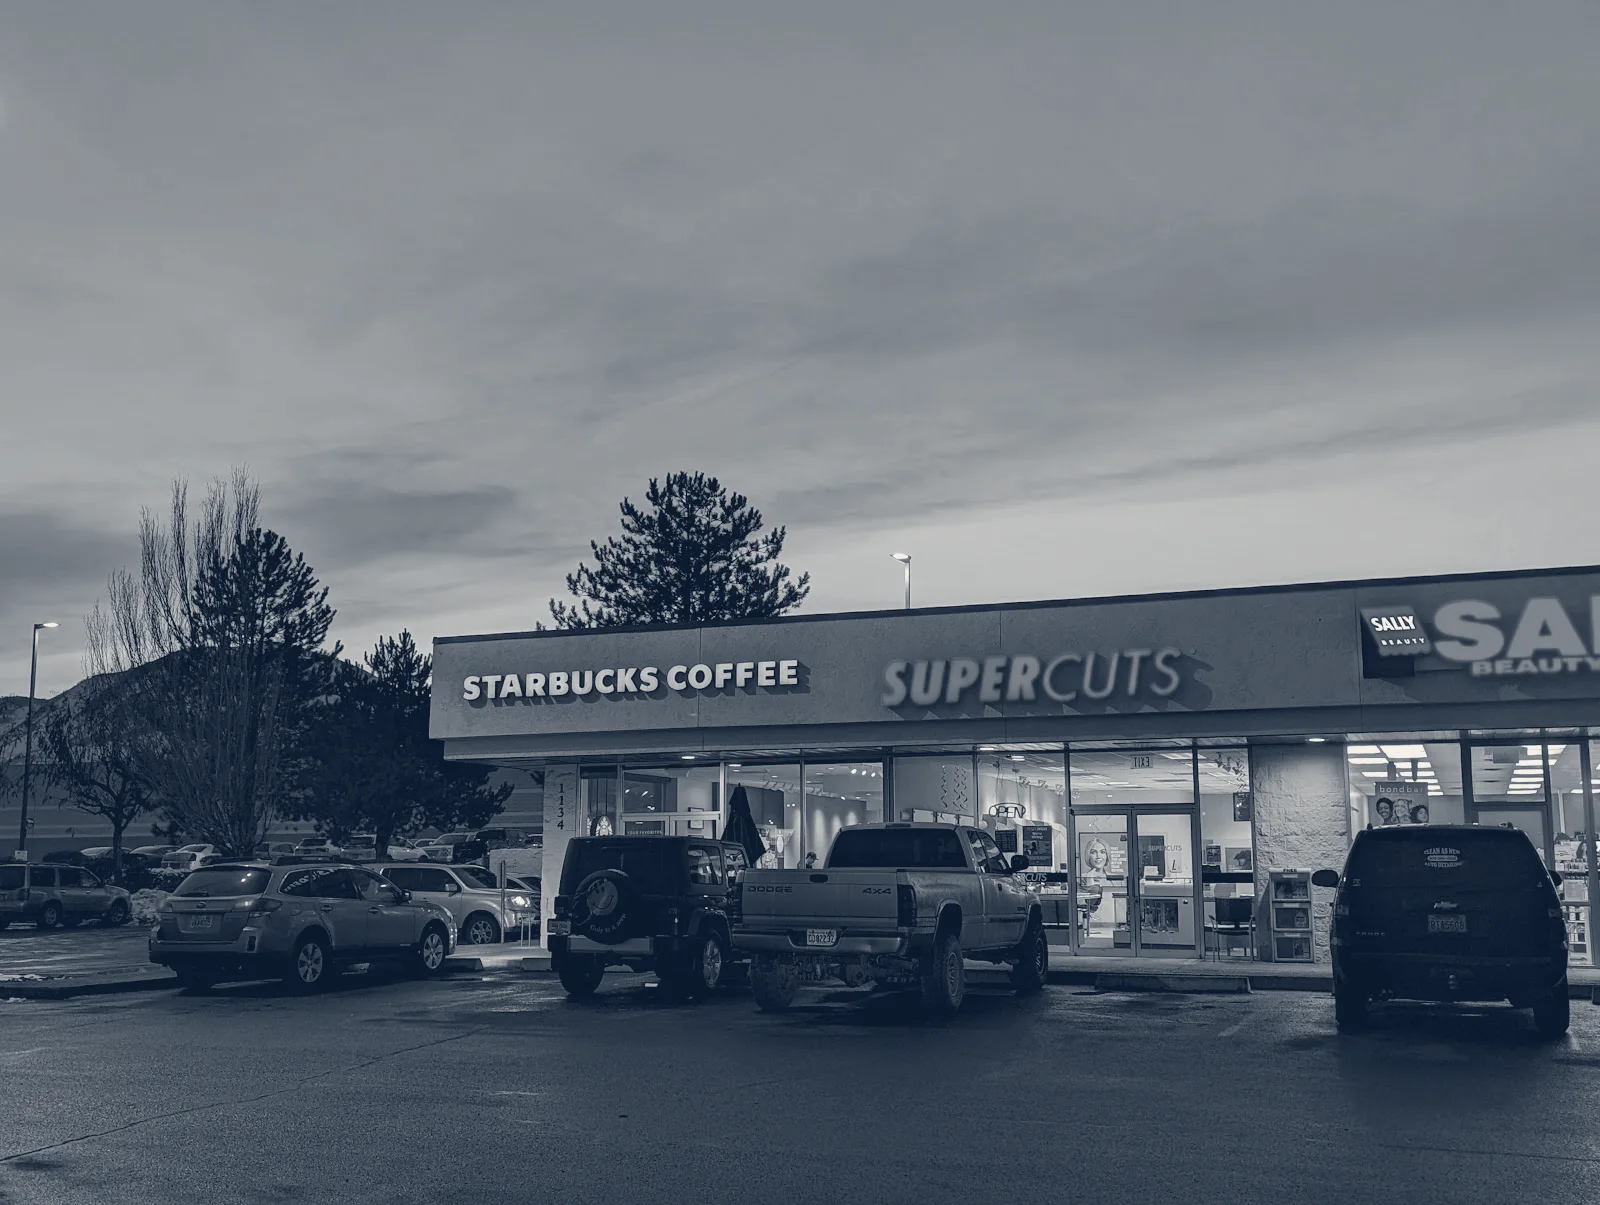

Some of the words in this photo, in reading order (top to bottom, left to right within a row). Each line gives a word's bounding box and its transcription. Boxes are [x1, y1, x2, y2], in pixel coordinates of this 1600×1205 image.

[1370, 615, 1416, 632] SALLY
[1381, 638, 1425, 646] BEAUTY
[463, 666, 658, 701] STARBUCKS
[667, 659, 799, 691] COFFEE
[882, 646, 1181, 707] SUPERCUTS
[557, 783, 565, 831] 1134
[988, 805, 1024, 819] OPEN
[1147, 844, 1183, 852] SUPERCUTS
[1423, 847, 1441, 855] CLEAN
[1441, 847, 1449, 855] AS
[747, 885, 793, 893] DODGE
